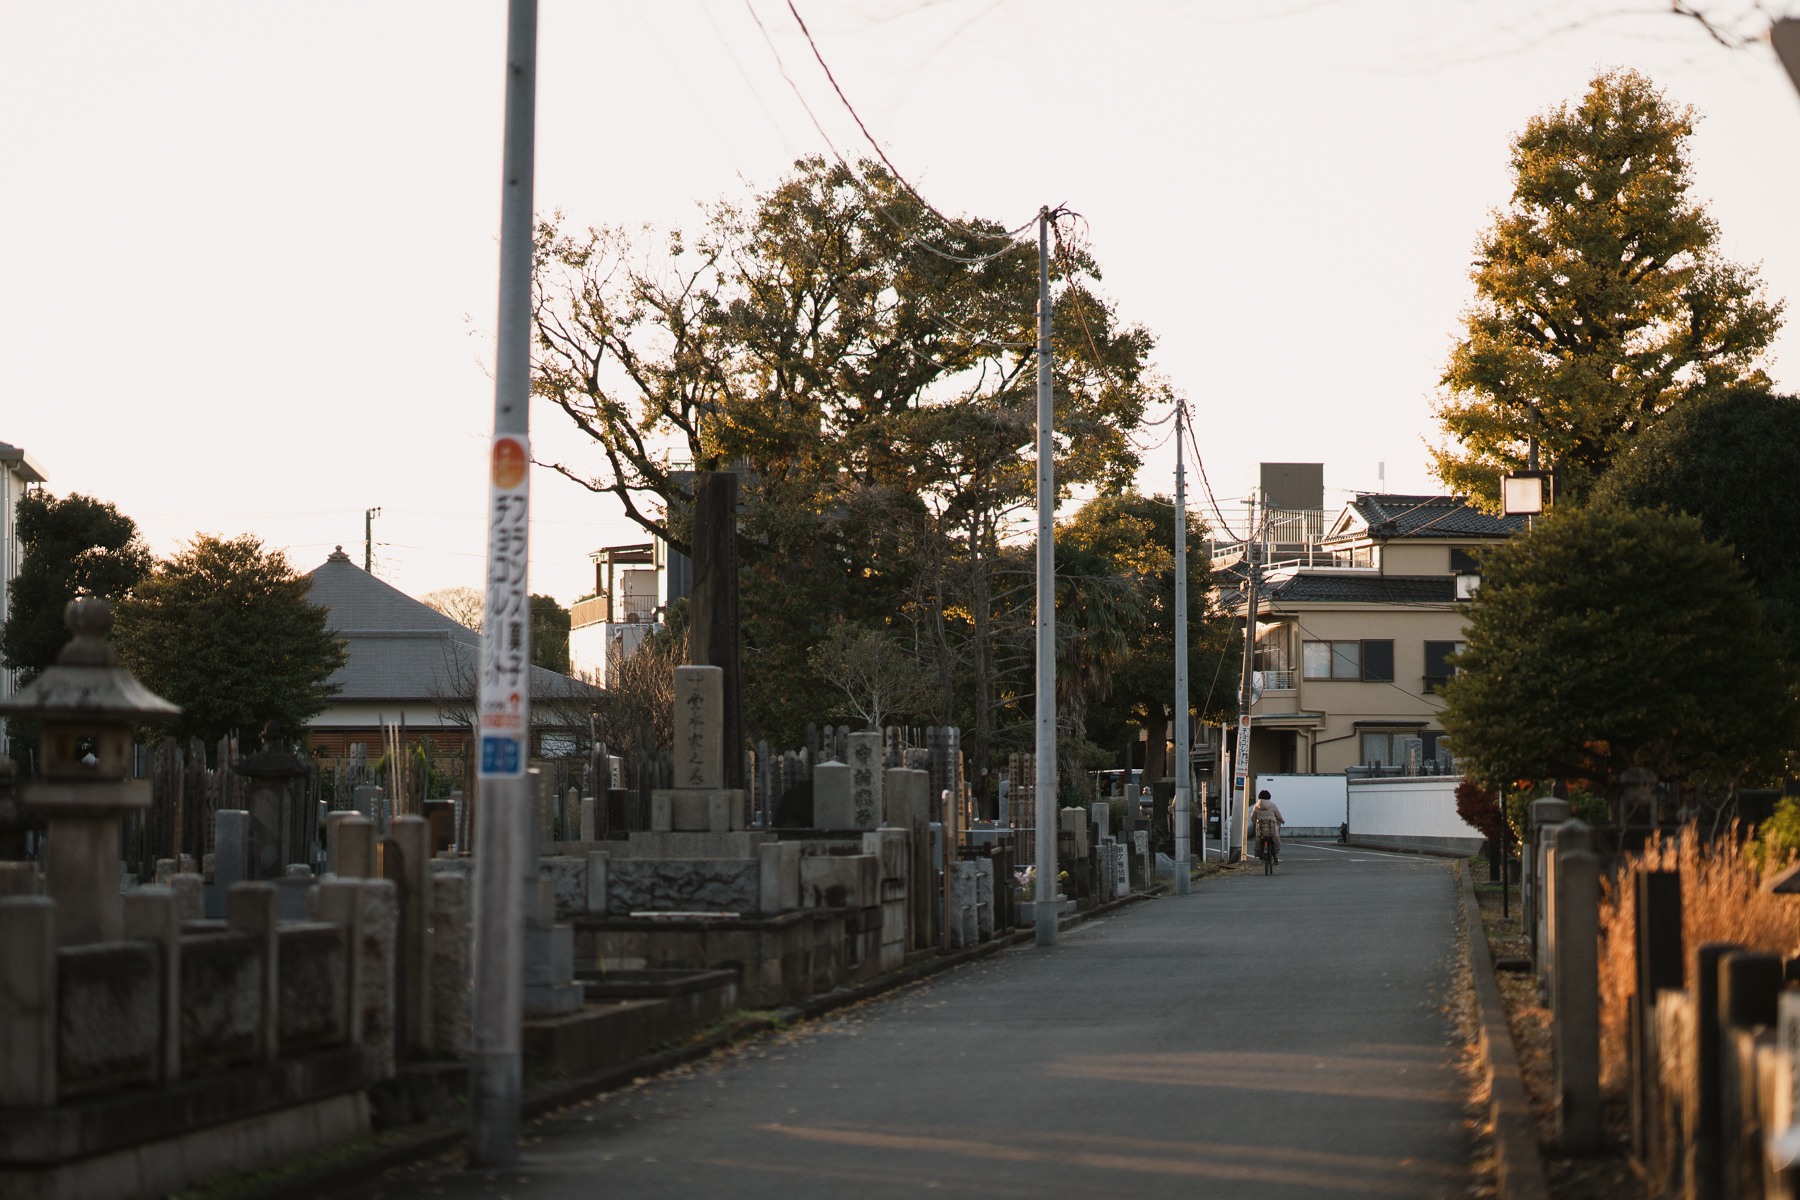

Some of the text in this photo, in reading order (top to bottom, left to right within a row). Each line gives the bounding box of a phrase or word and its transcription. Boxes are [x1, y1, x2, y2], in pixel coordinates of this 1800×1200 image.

[492, 495, 511, 688] チョコレート
[506, 495, 527, 688] フランス菓子
